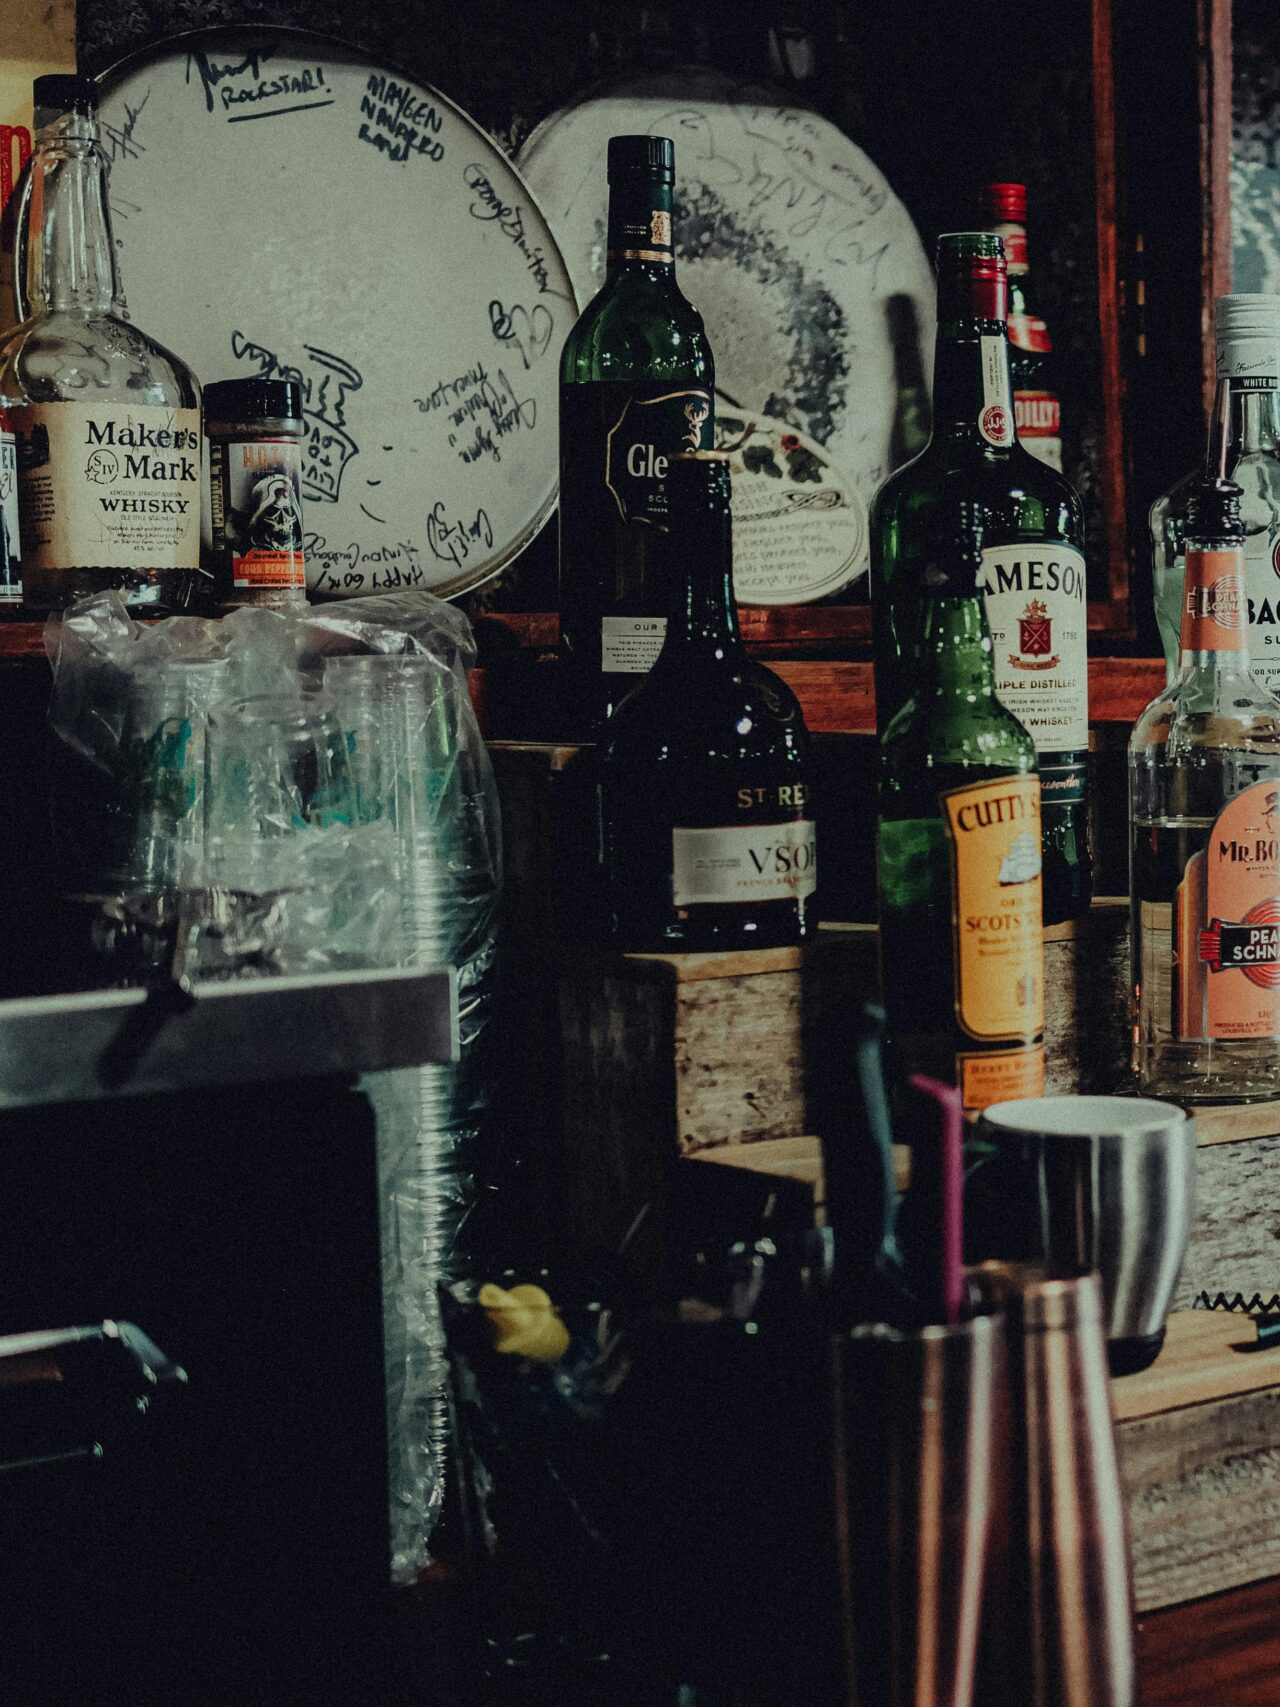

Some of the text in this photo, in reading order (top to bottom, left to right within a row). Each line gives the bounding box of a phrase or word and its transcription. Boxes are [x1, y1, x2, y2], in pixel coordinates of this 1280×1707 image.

[1243, 378, 1267, 387] WHITE
[84, 420, 199, 450] Maker's
[123, 455, 197, 482] Mark
[99, 498, 190, 514] WHISKY
[372, 566, 424, 589] HAPPY
[983, 561, 1084, 604] AMESON
[995, 679, 1077, 690] IPLE DISTILLED
[1029, 716, 1073, 727] WHISKEY
